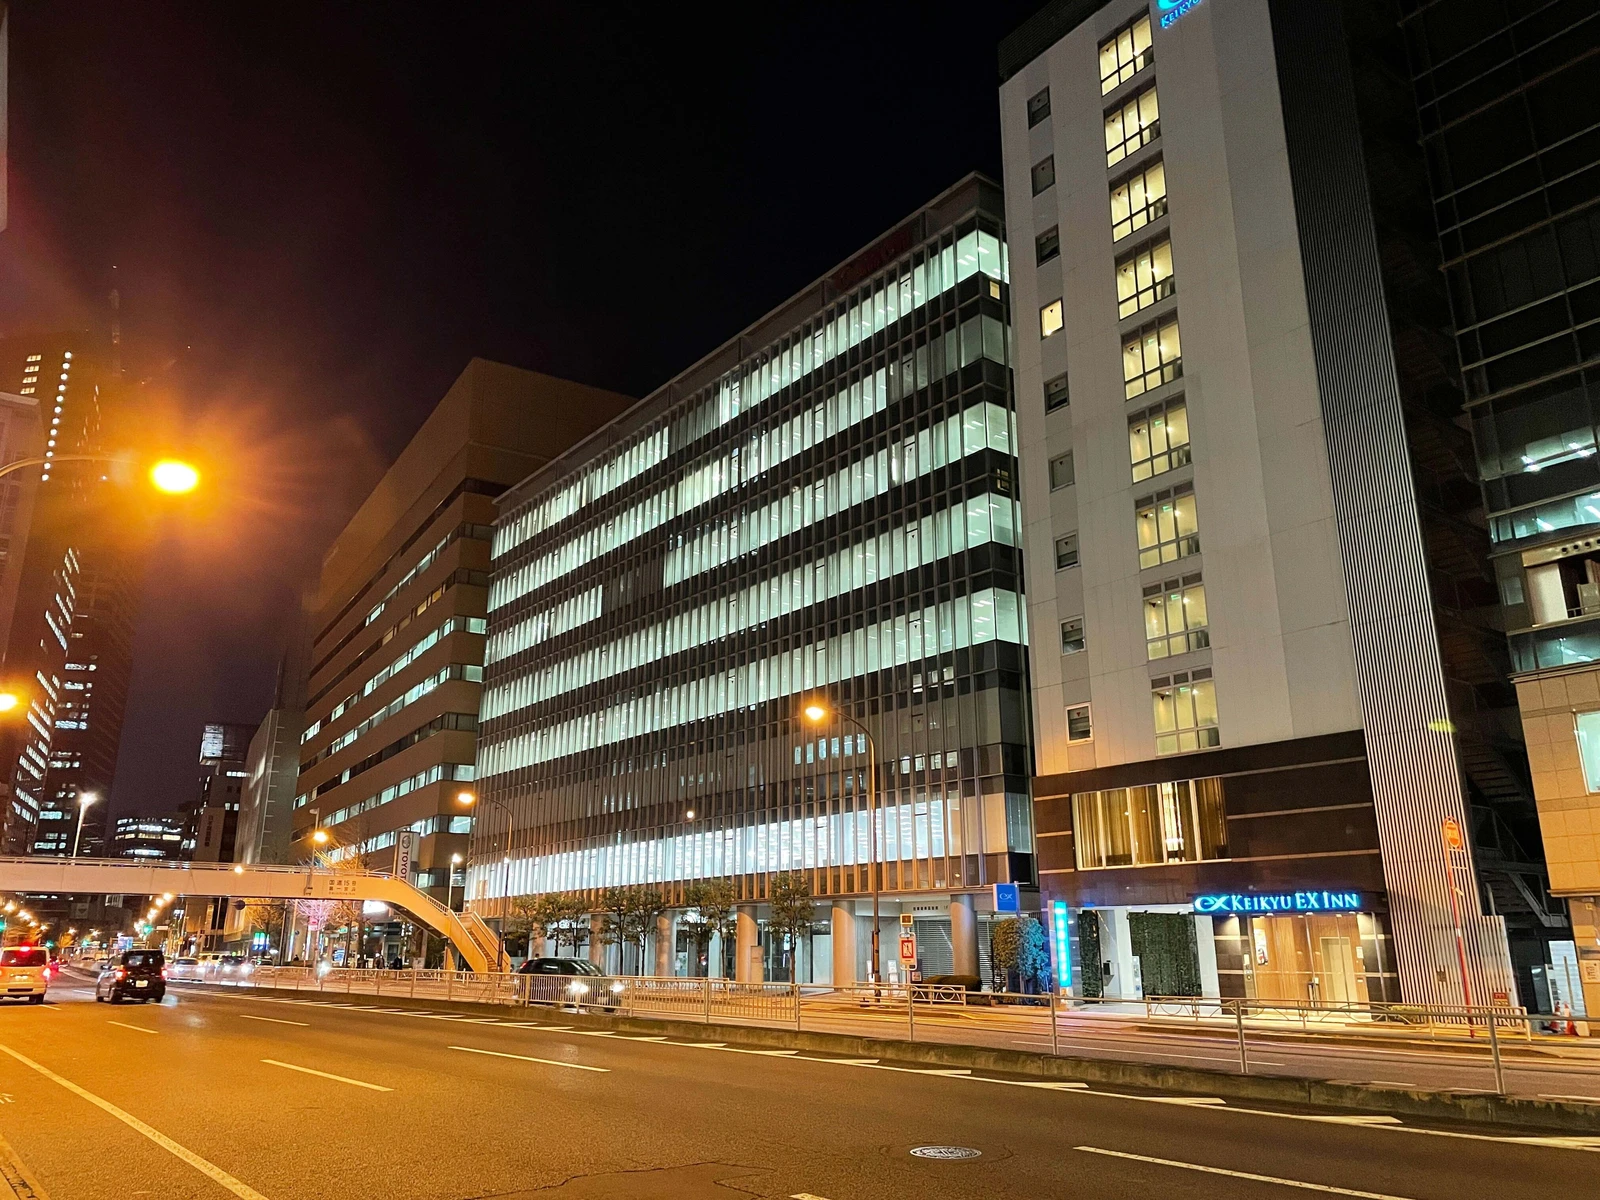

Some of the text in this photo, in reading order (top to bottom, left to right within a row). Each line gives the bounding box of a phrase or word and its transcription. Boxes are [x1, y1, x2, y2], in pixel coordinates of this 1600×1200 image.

[400, 851, 409, 880] TOYOT
[1231, 894, 1291, 911] KEIKYU
[1295, 892, 1320, 909] EX
